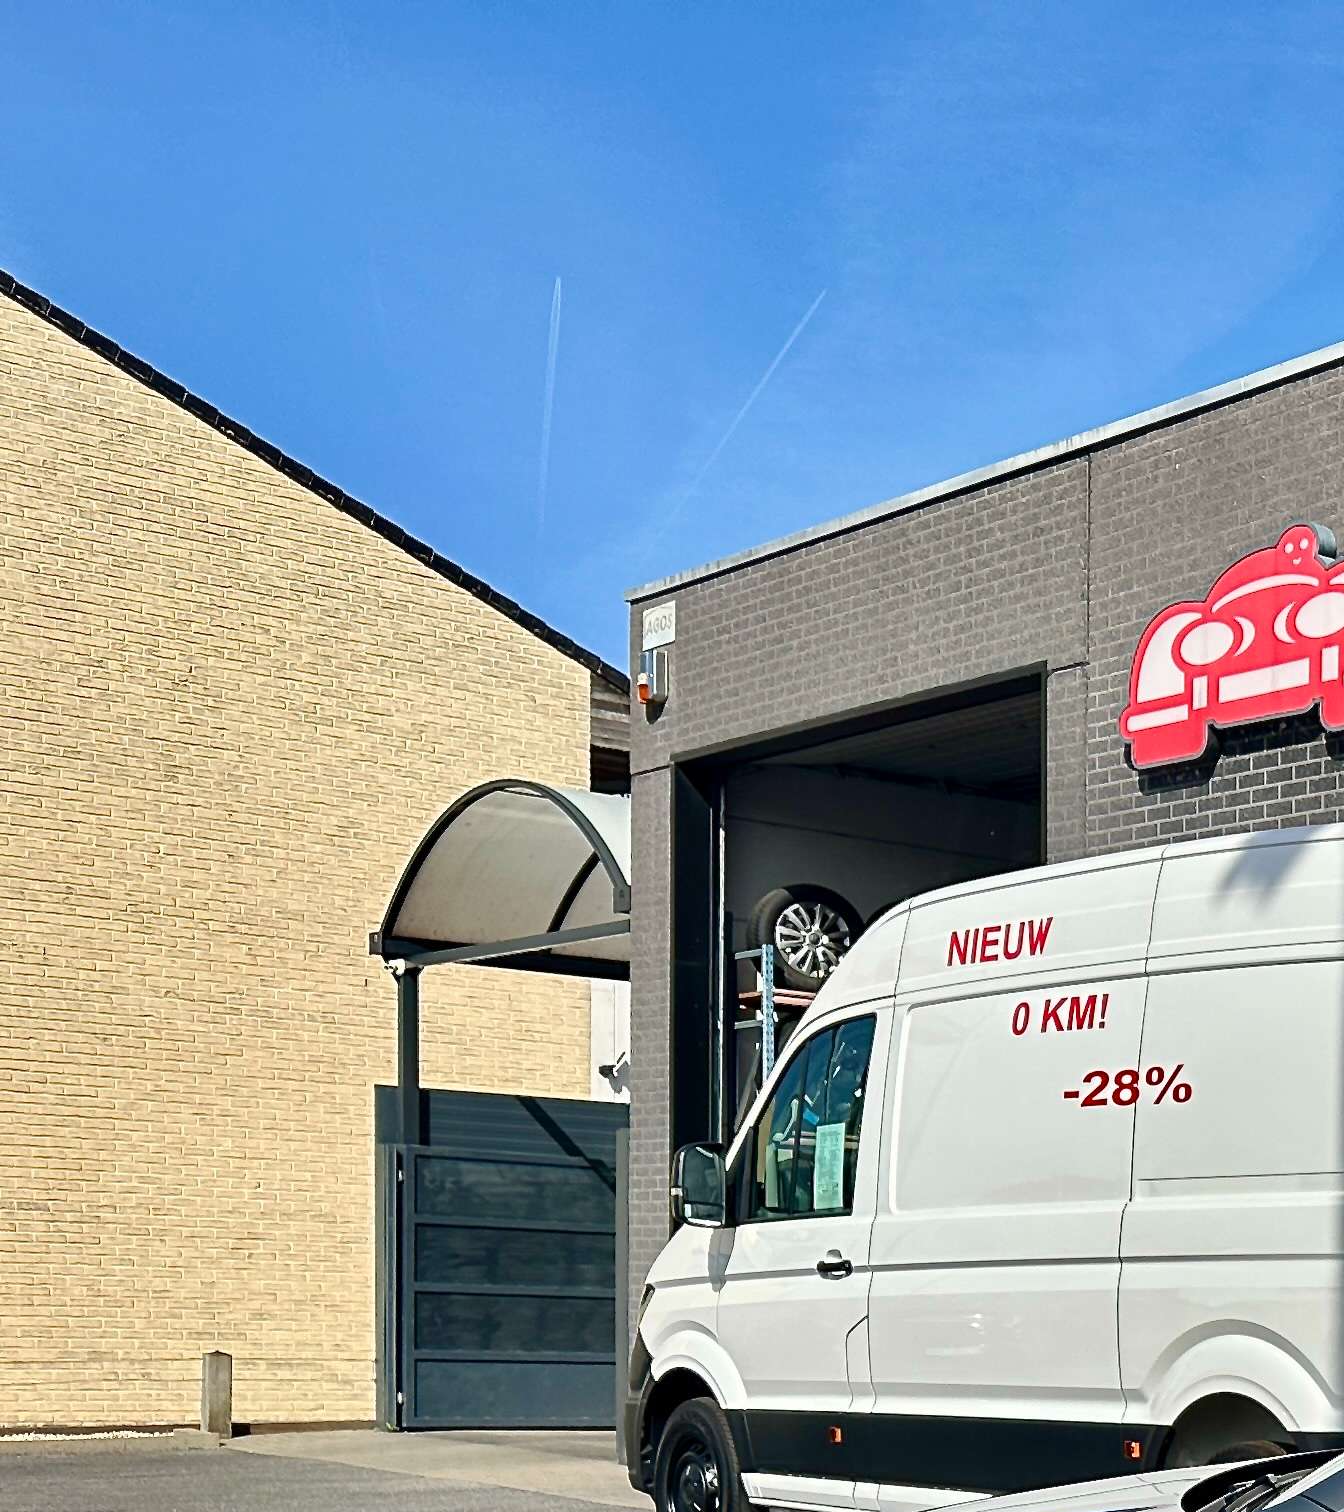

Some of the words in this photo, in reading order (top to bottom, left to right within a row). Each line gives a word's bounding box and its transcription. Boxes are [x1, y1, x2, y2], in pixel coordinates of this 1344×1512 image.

[946, 916, 1053, 967] NIEUW
[1010, 1001, 1031, 1037] 0
[1041, 993, 1110, 1034] KM!
[1062, 1063, 1193, 1109] -28%
